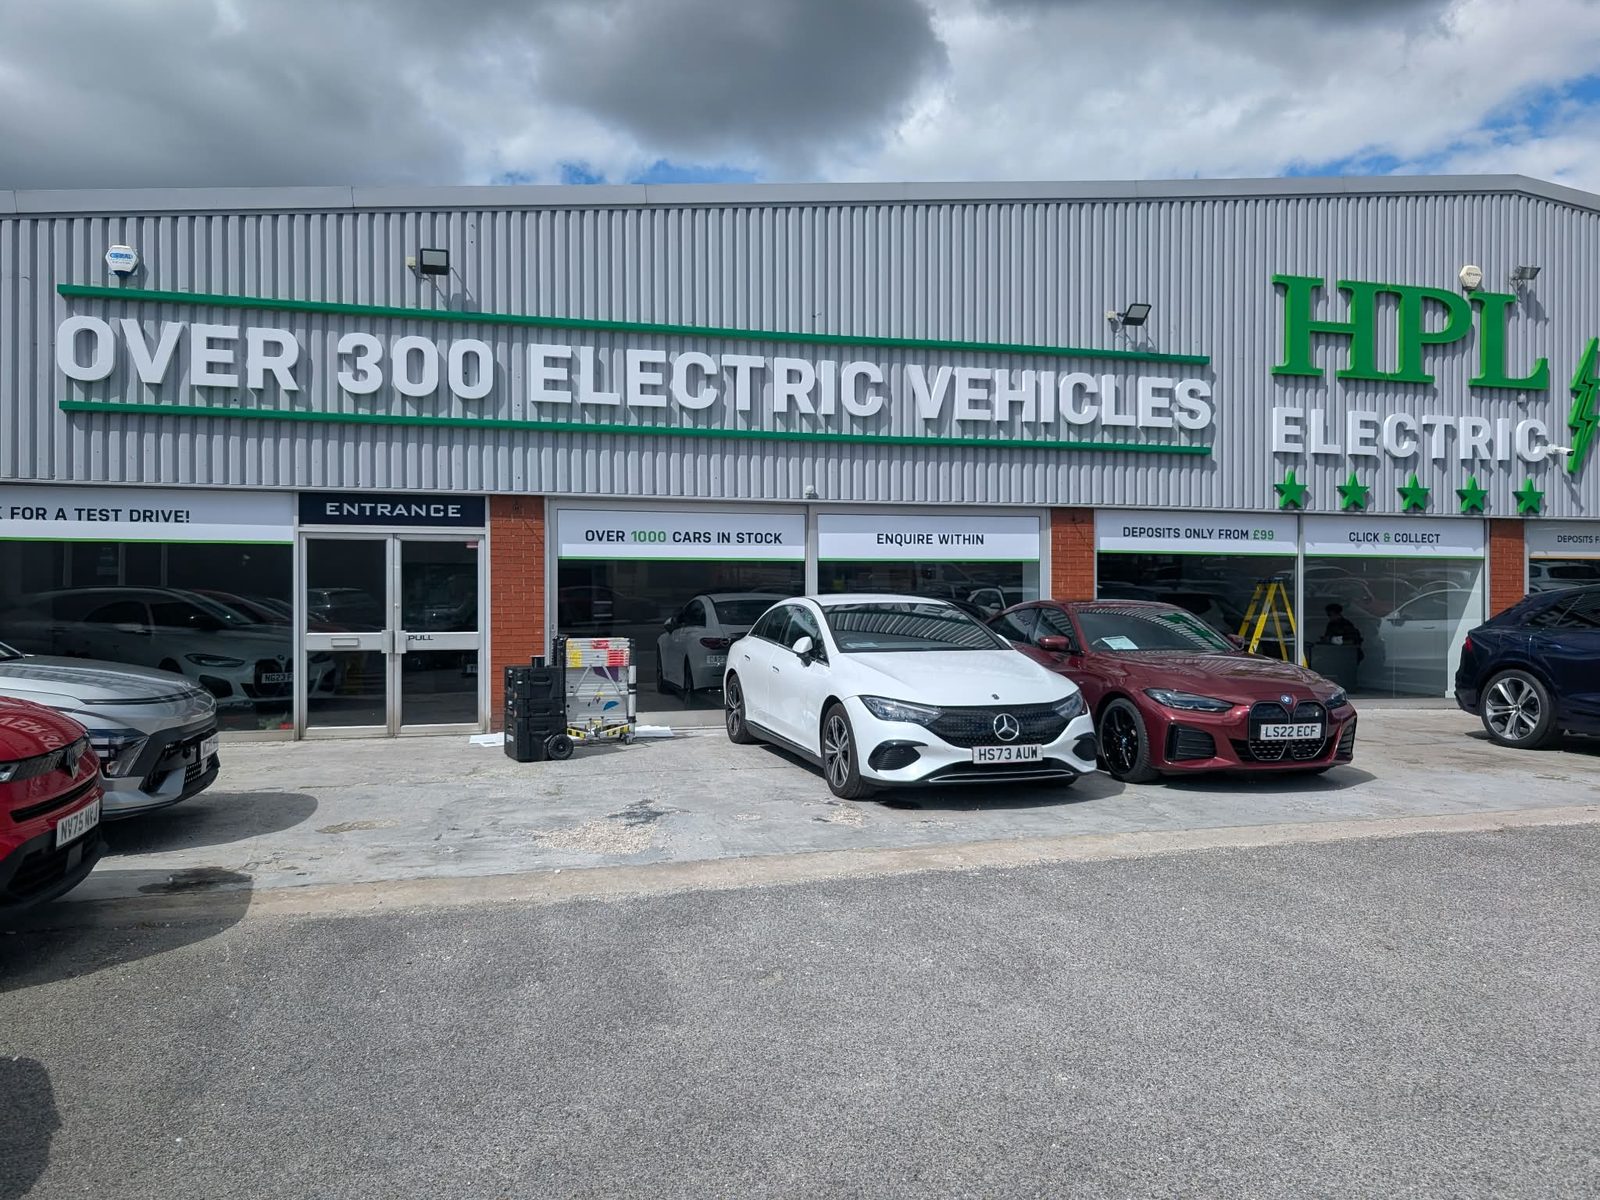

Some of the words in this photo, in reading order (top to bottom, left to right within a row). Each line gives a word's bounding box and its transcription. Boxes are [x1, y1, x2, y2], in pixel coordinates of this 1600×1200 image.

[1271, 274, 1549, 390] HPL
[57, 315, 300, 391] OVER
[337, 332, 494, 399] 300
[530, 343, 884, 417] ELECTRIC
[908, 363, 1212, 429] VEHICLES
[1272, 406, 1548, 463] ELECTRIC
[10, 506, 48, 521] FOR
[54, 507, 68, 521] A
[74, 508, 123, 522] TEST
[129, 509, 190, 523] DRIVE!
[326, 502, 461, 518] ENTRANCE
[585, 529, 626, 542] OVER
[631, 530, 667, 543] 1000
[672, 531, 712, 543] CARS
[717, 532, 731, 544] IN
[736, 532, 783, 544] STOCK
[876, 533, 934, 547] ENQUIRE
[938, 533, 985, 545] WITHIN
[1122, 526, 1181, 539] DEPOSITS
[1184, 528, 1215, 540] ONLY
[1218, 528, 1249, 540] FROM
[1252, 529, 1275, 541] £99
[1348, 531, 1380, 543] CLICK
[1383, 532, 1392, 543] &
[1394, 532, 1441, 544] COLLECT
[1557, 535, 1594, 544] DEPOSITS
[1265, 726, 1295, 738] LS22
[1296, 725, 1318, 737] ECF
[978, 748, 1012, 761] HS73
[1015, 746, 1038, 760] AUW
